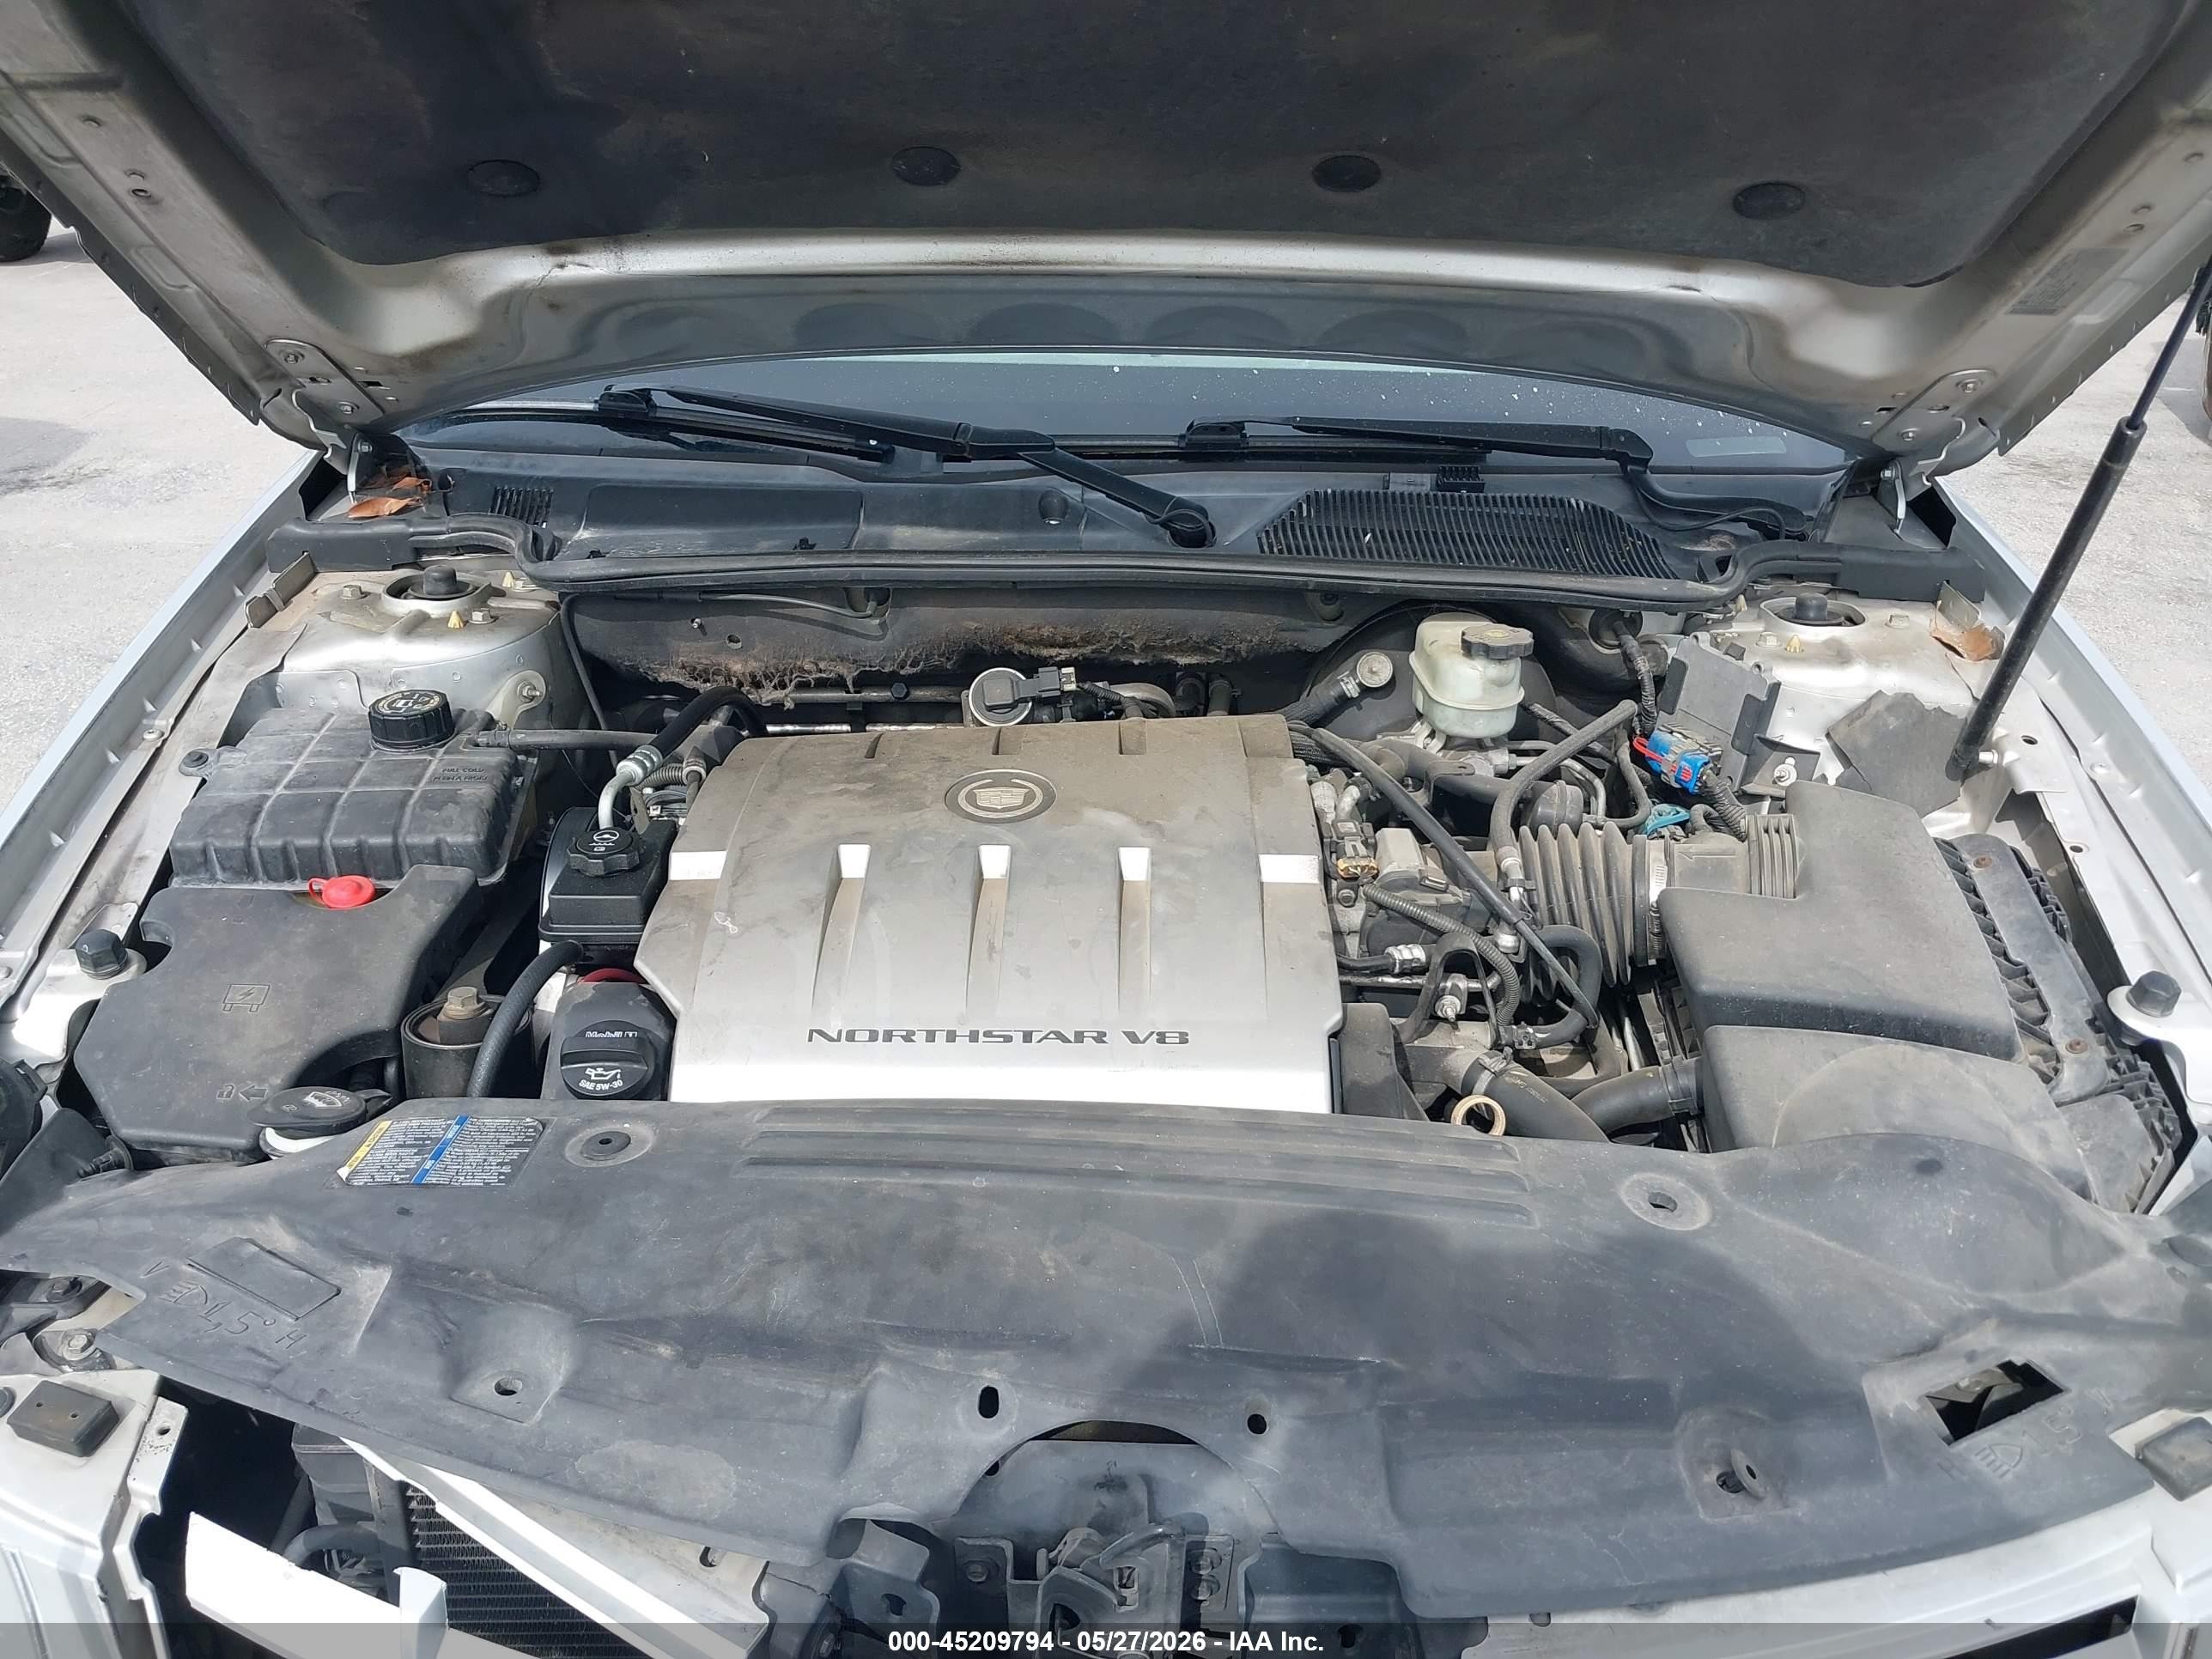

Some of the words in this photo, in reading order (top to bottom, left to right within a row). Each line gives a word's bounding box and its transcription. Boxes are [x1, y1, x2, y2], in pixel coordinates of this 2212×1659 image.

[807, 1028, 1109, 1044] NORTHSTAR
[1120, 1030, 1190, 1045] V8
[579, 1079, 596, 1090] SAE
[595, 1079, 623, 1091] 5W-30
